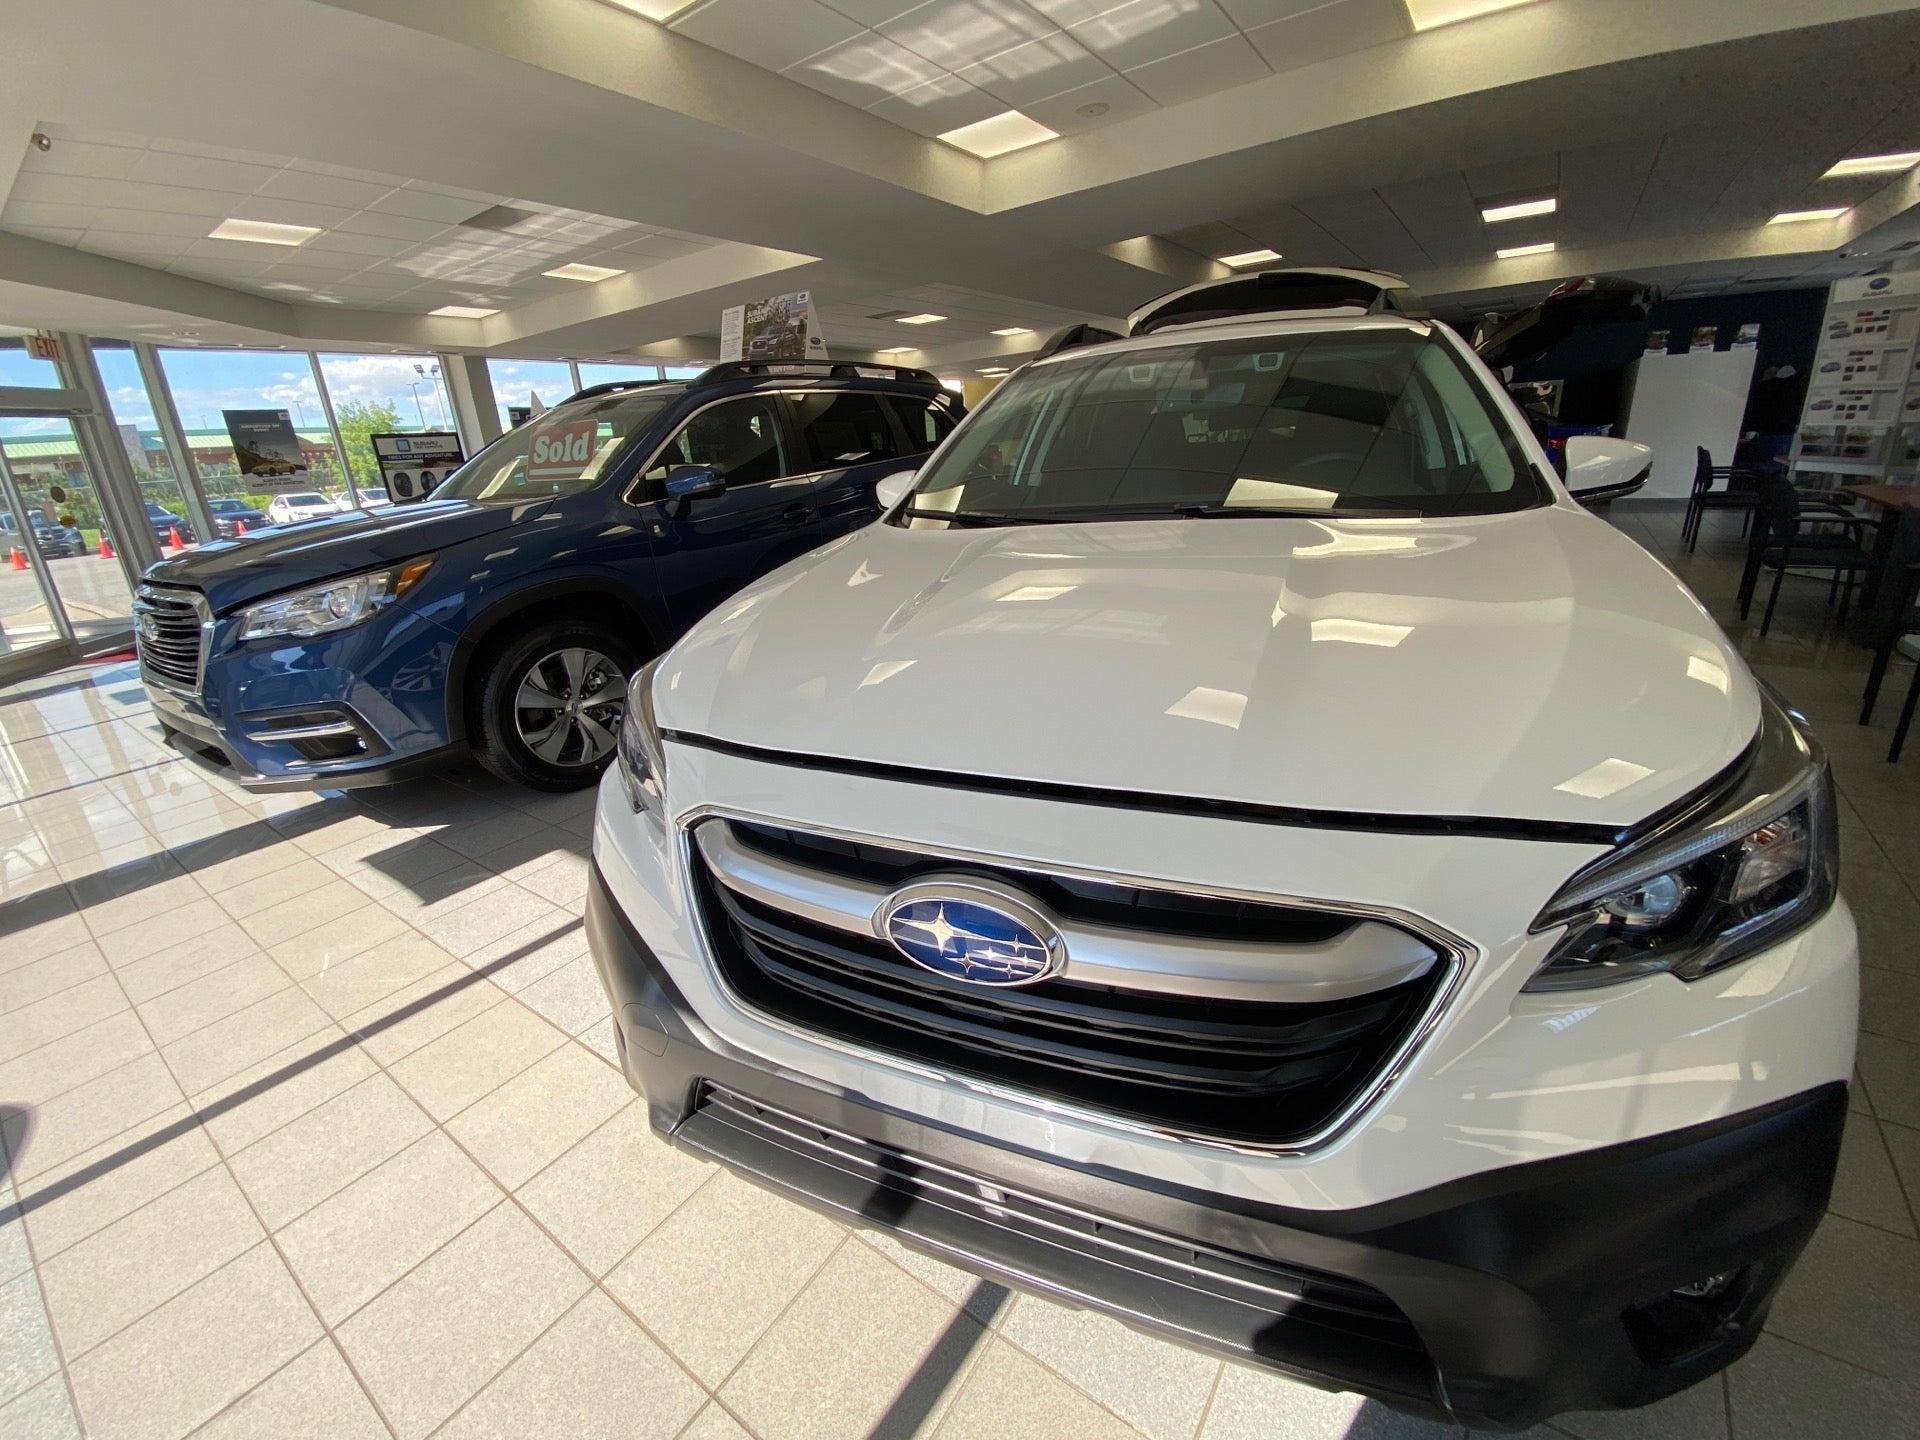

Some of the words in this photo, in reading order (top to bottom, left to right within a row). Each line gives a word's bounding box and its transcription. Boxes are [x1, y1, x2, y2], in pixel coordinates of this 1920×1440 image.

[747, 313, 769, 325] ASCENT
[35, 336, 60, 358] EXIT
[534, 431, 589, 464] Sold
